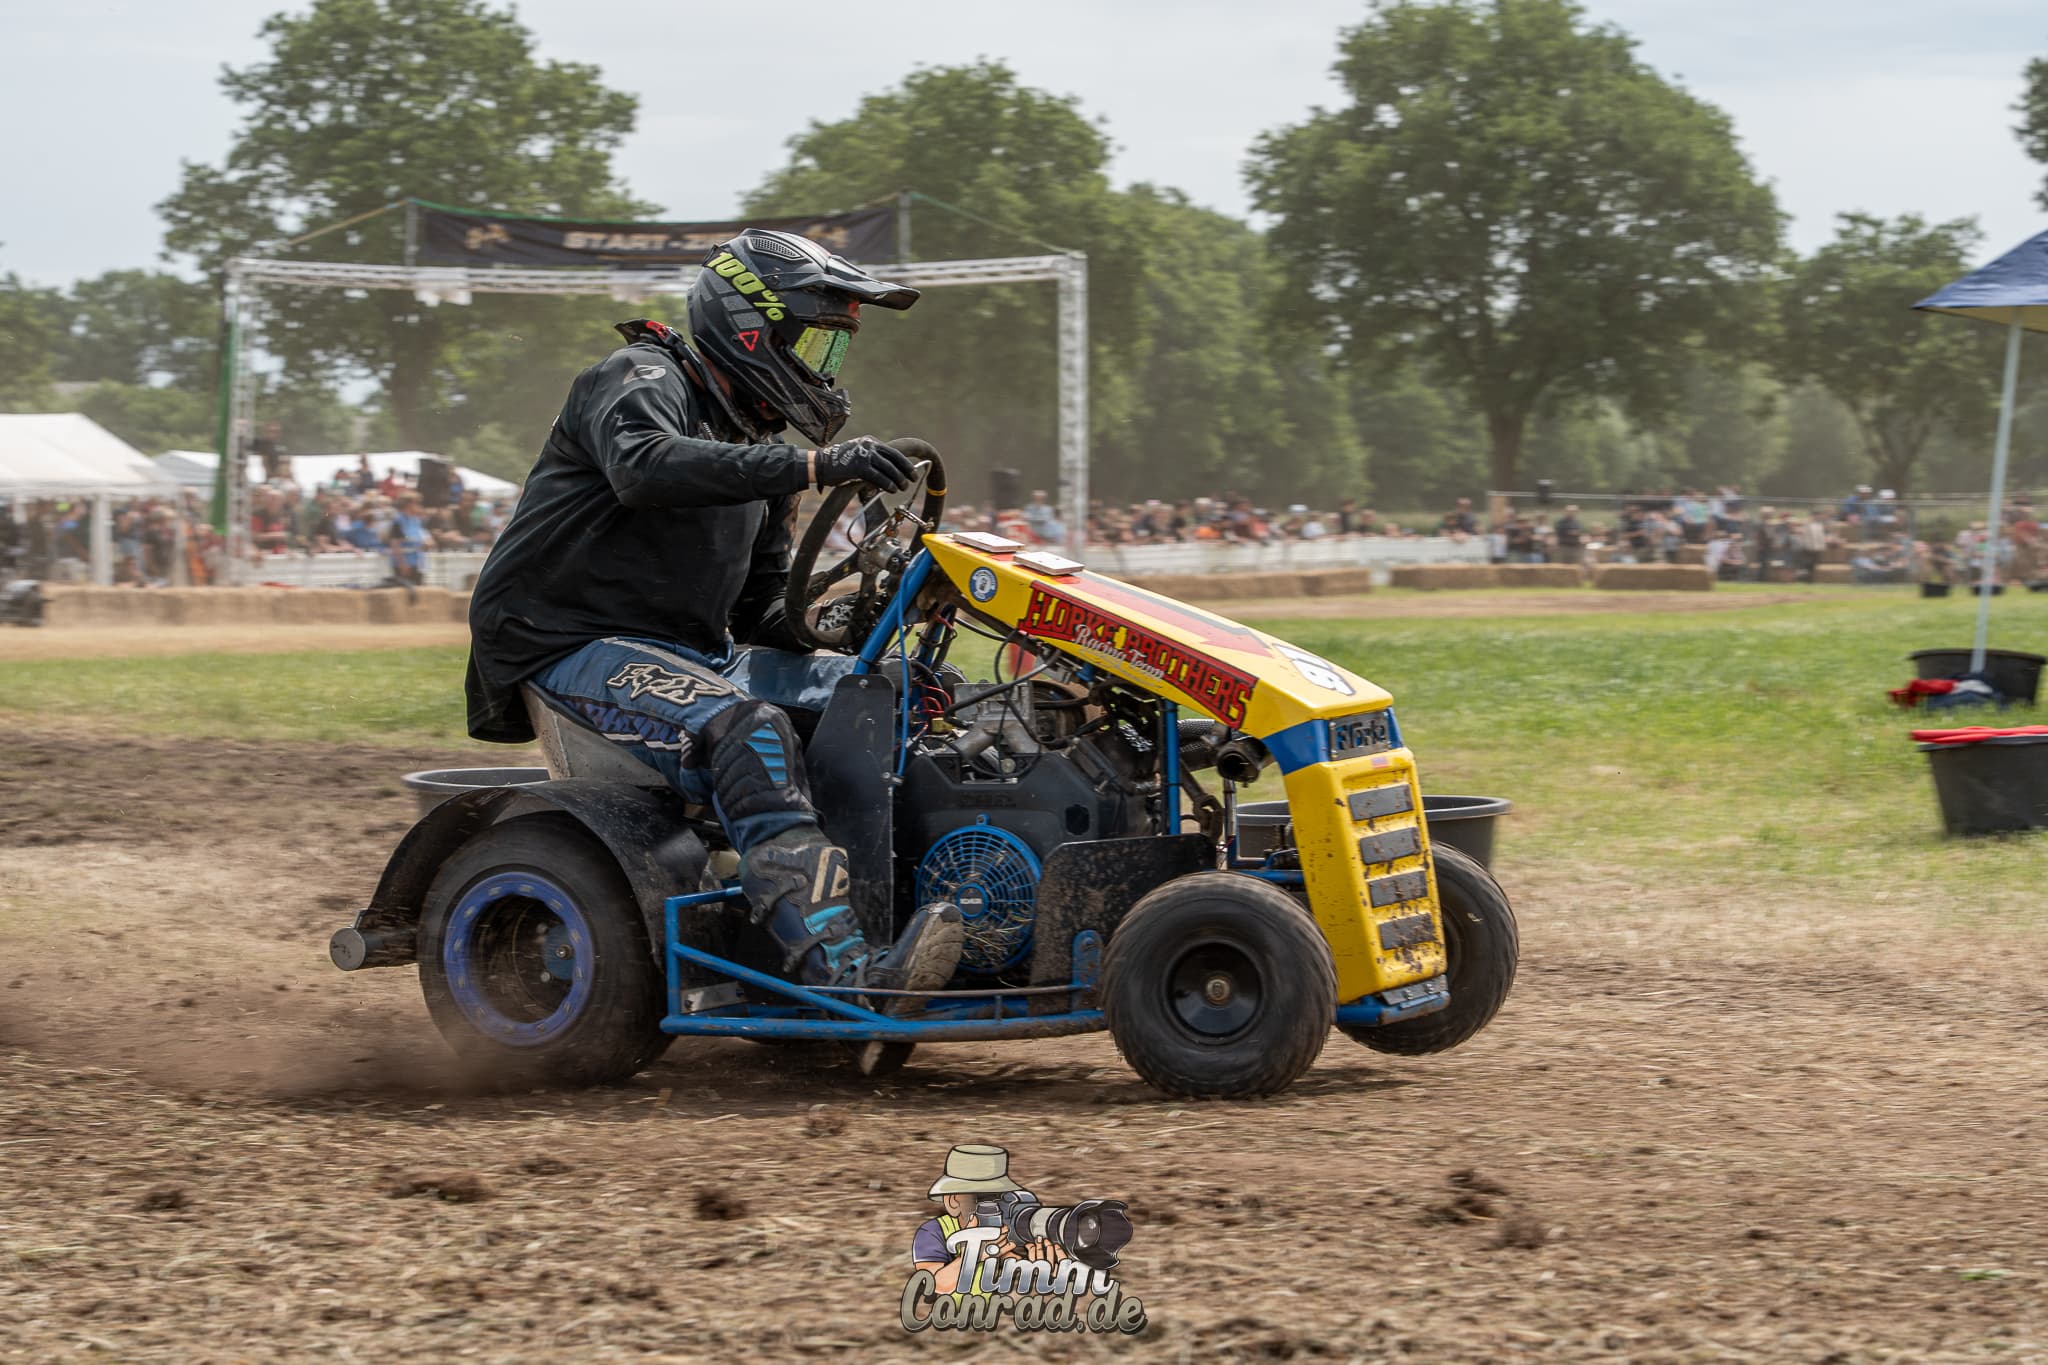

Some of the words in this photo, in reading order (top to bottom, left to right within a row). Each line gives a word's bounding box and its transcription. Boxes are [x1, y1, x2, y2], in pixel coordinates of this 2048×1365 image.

[706, 252, 785, 321] 100%
[1073, 624, 1128, 662] Racing
[1127, 648, 1165, 680] Team
[1123, 627, 1254, 729] BROTHERS
